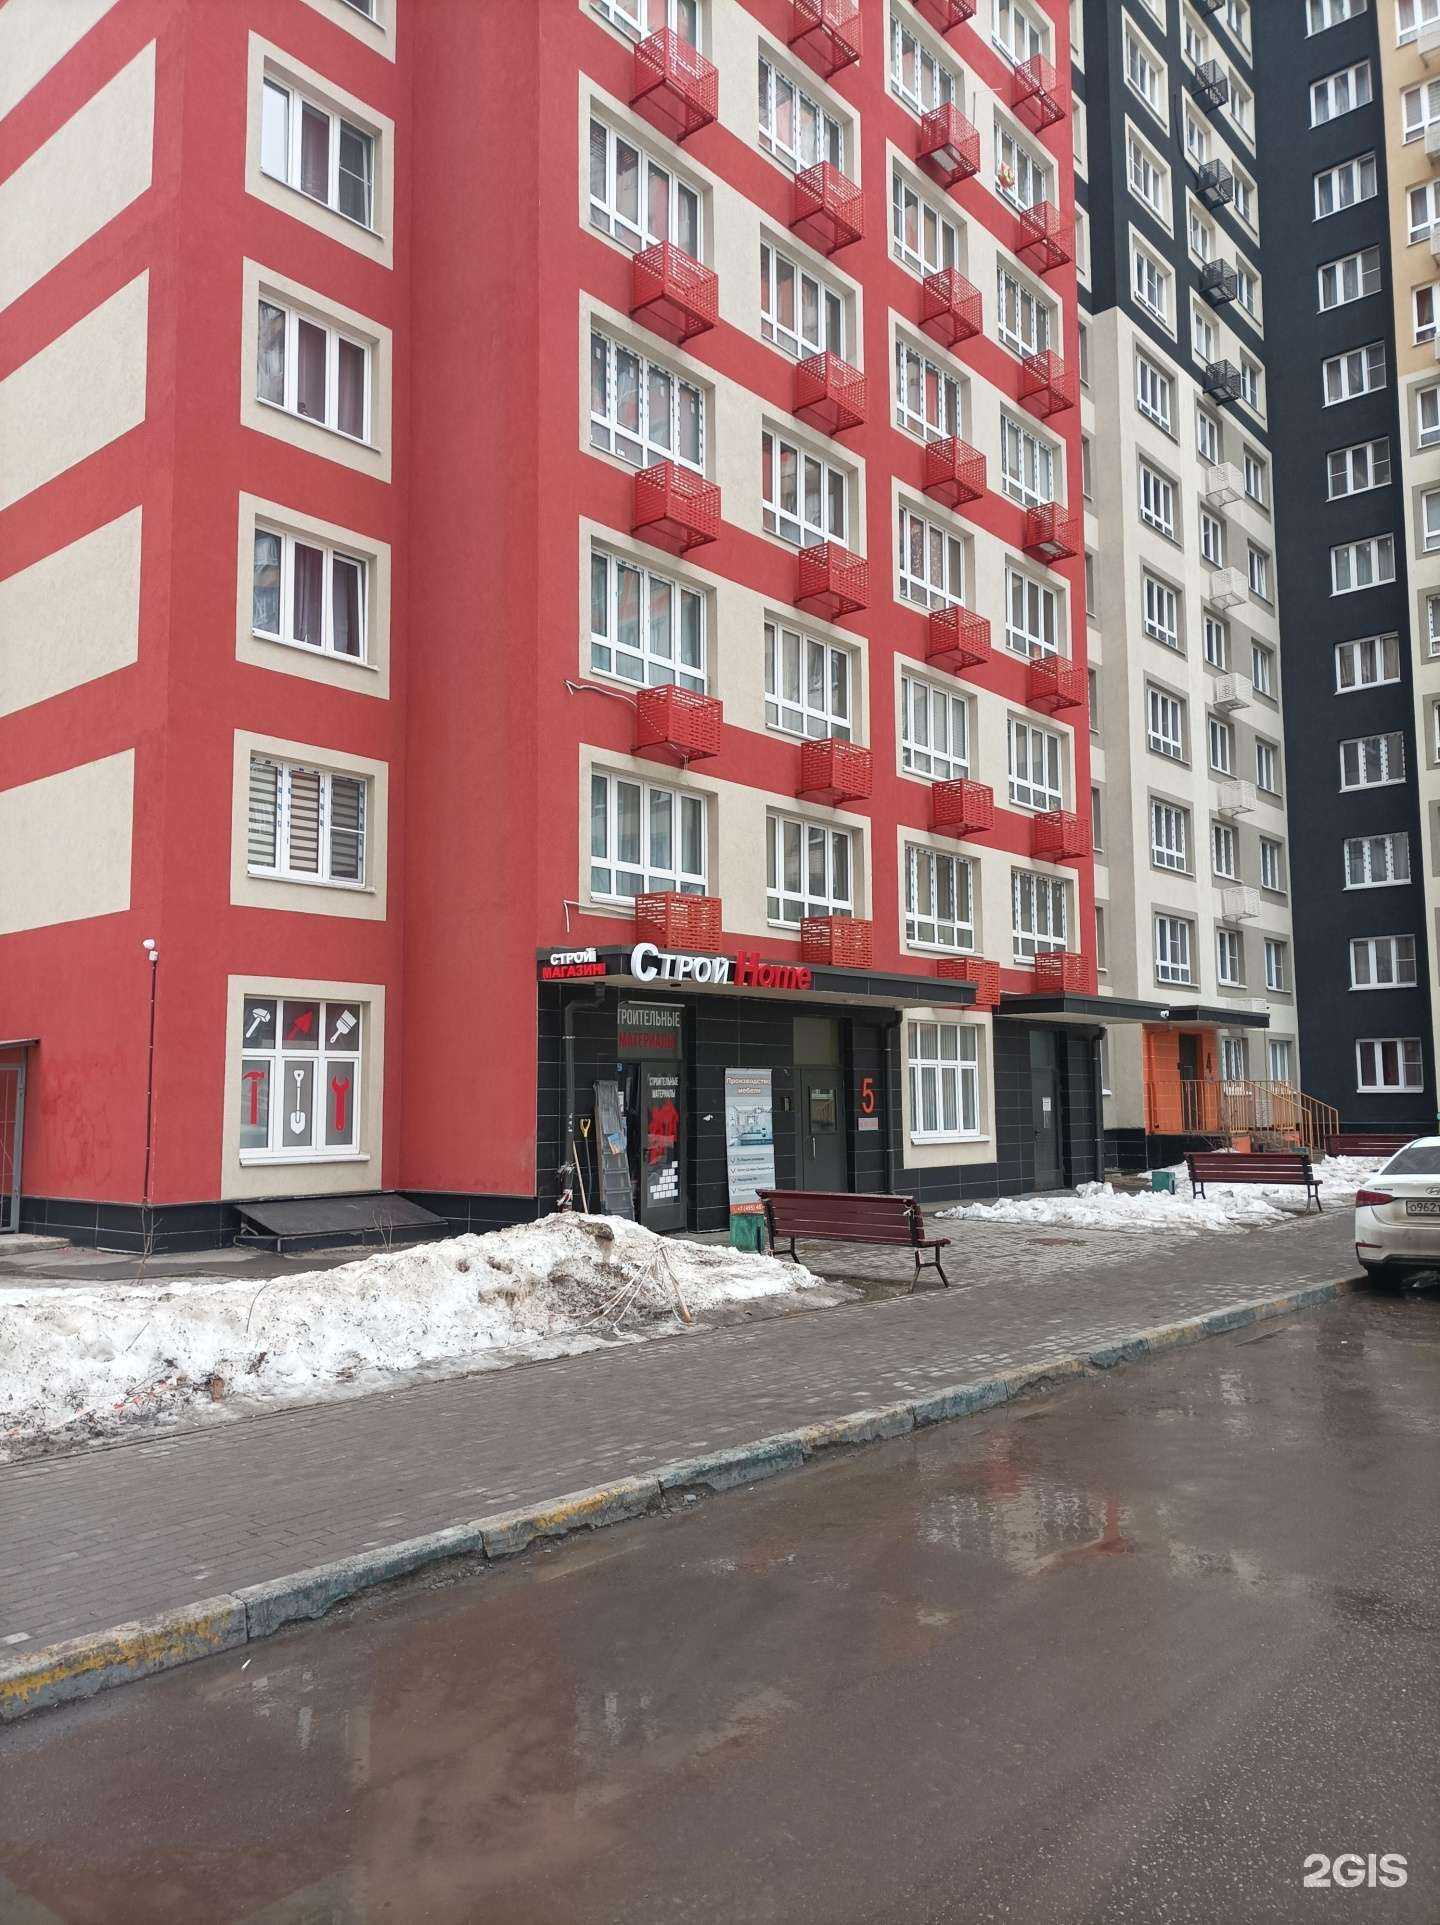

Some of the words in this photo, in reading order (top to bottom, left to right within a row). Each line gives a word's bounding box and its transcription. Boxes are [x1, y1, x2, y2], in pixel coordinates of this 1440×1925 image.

[550, 947, 597, 965] СТРОЙ
[733, 950, 812, 989] Home
[543, 962, 606, 979] МАГАЗИН
[863, 1077, 875, 1113] 5
